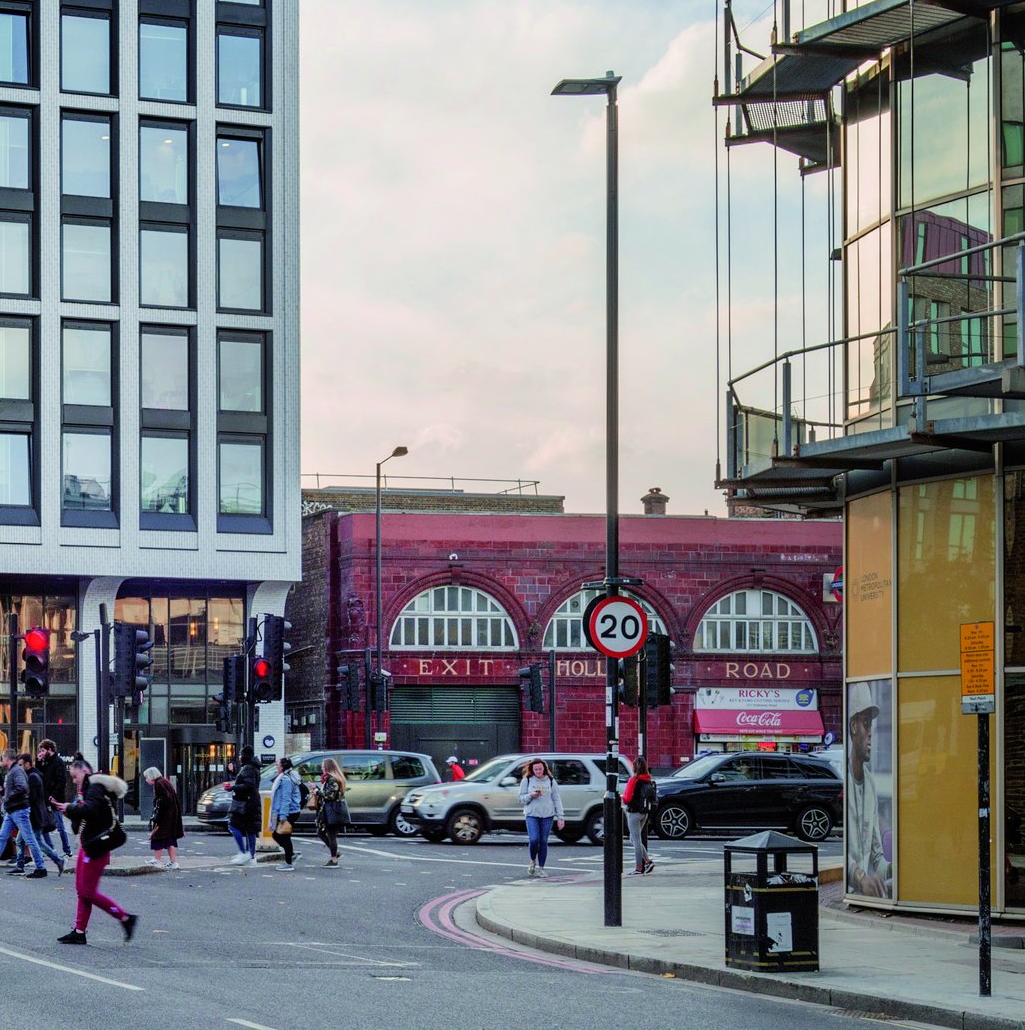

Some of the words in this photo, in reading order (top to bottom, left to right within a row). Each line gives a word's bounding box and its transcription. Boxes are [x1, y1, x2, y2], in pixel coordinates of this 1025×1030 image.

[600, 614, 639, 640] 20
[419, 659, 494, 676] EXIT
[725, 662, 791, 678] ROAD
[738, 689, 780, 698] RICKY'S
